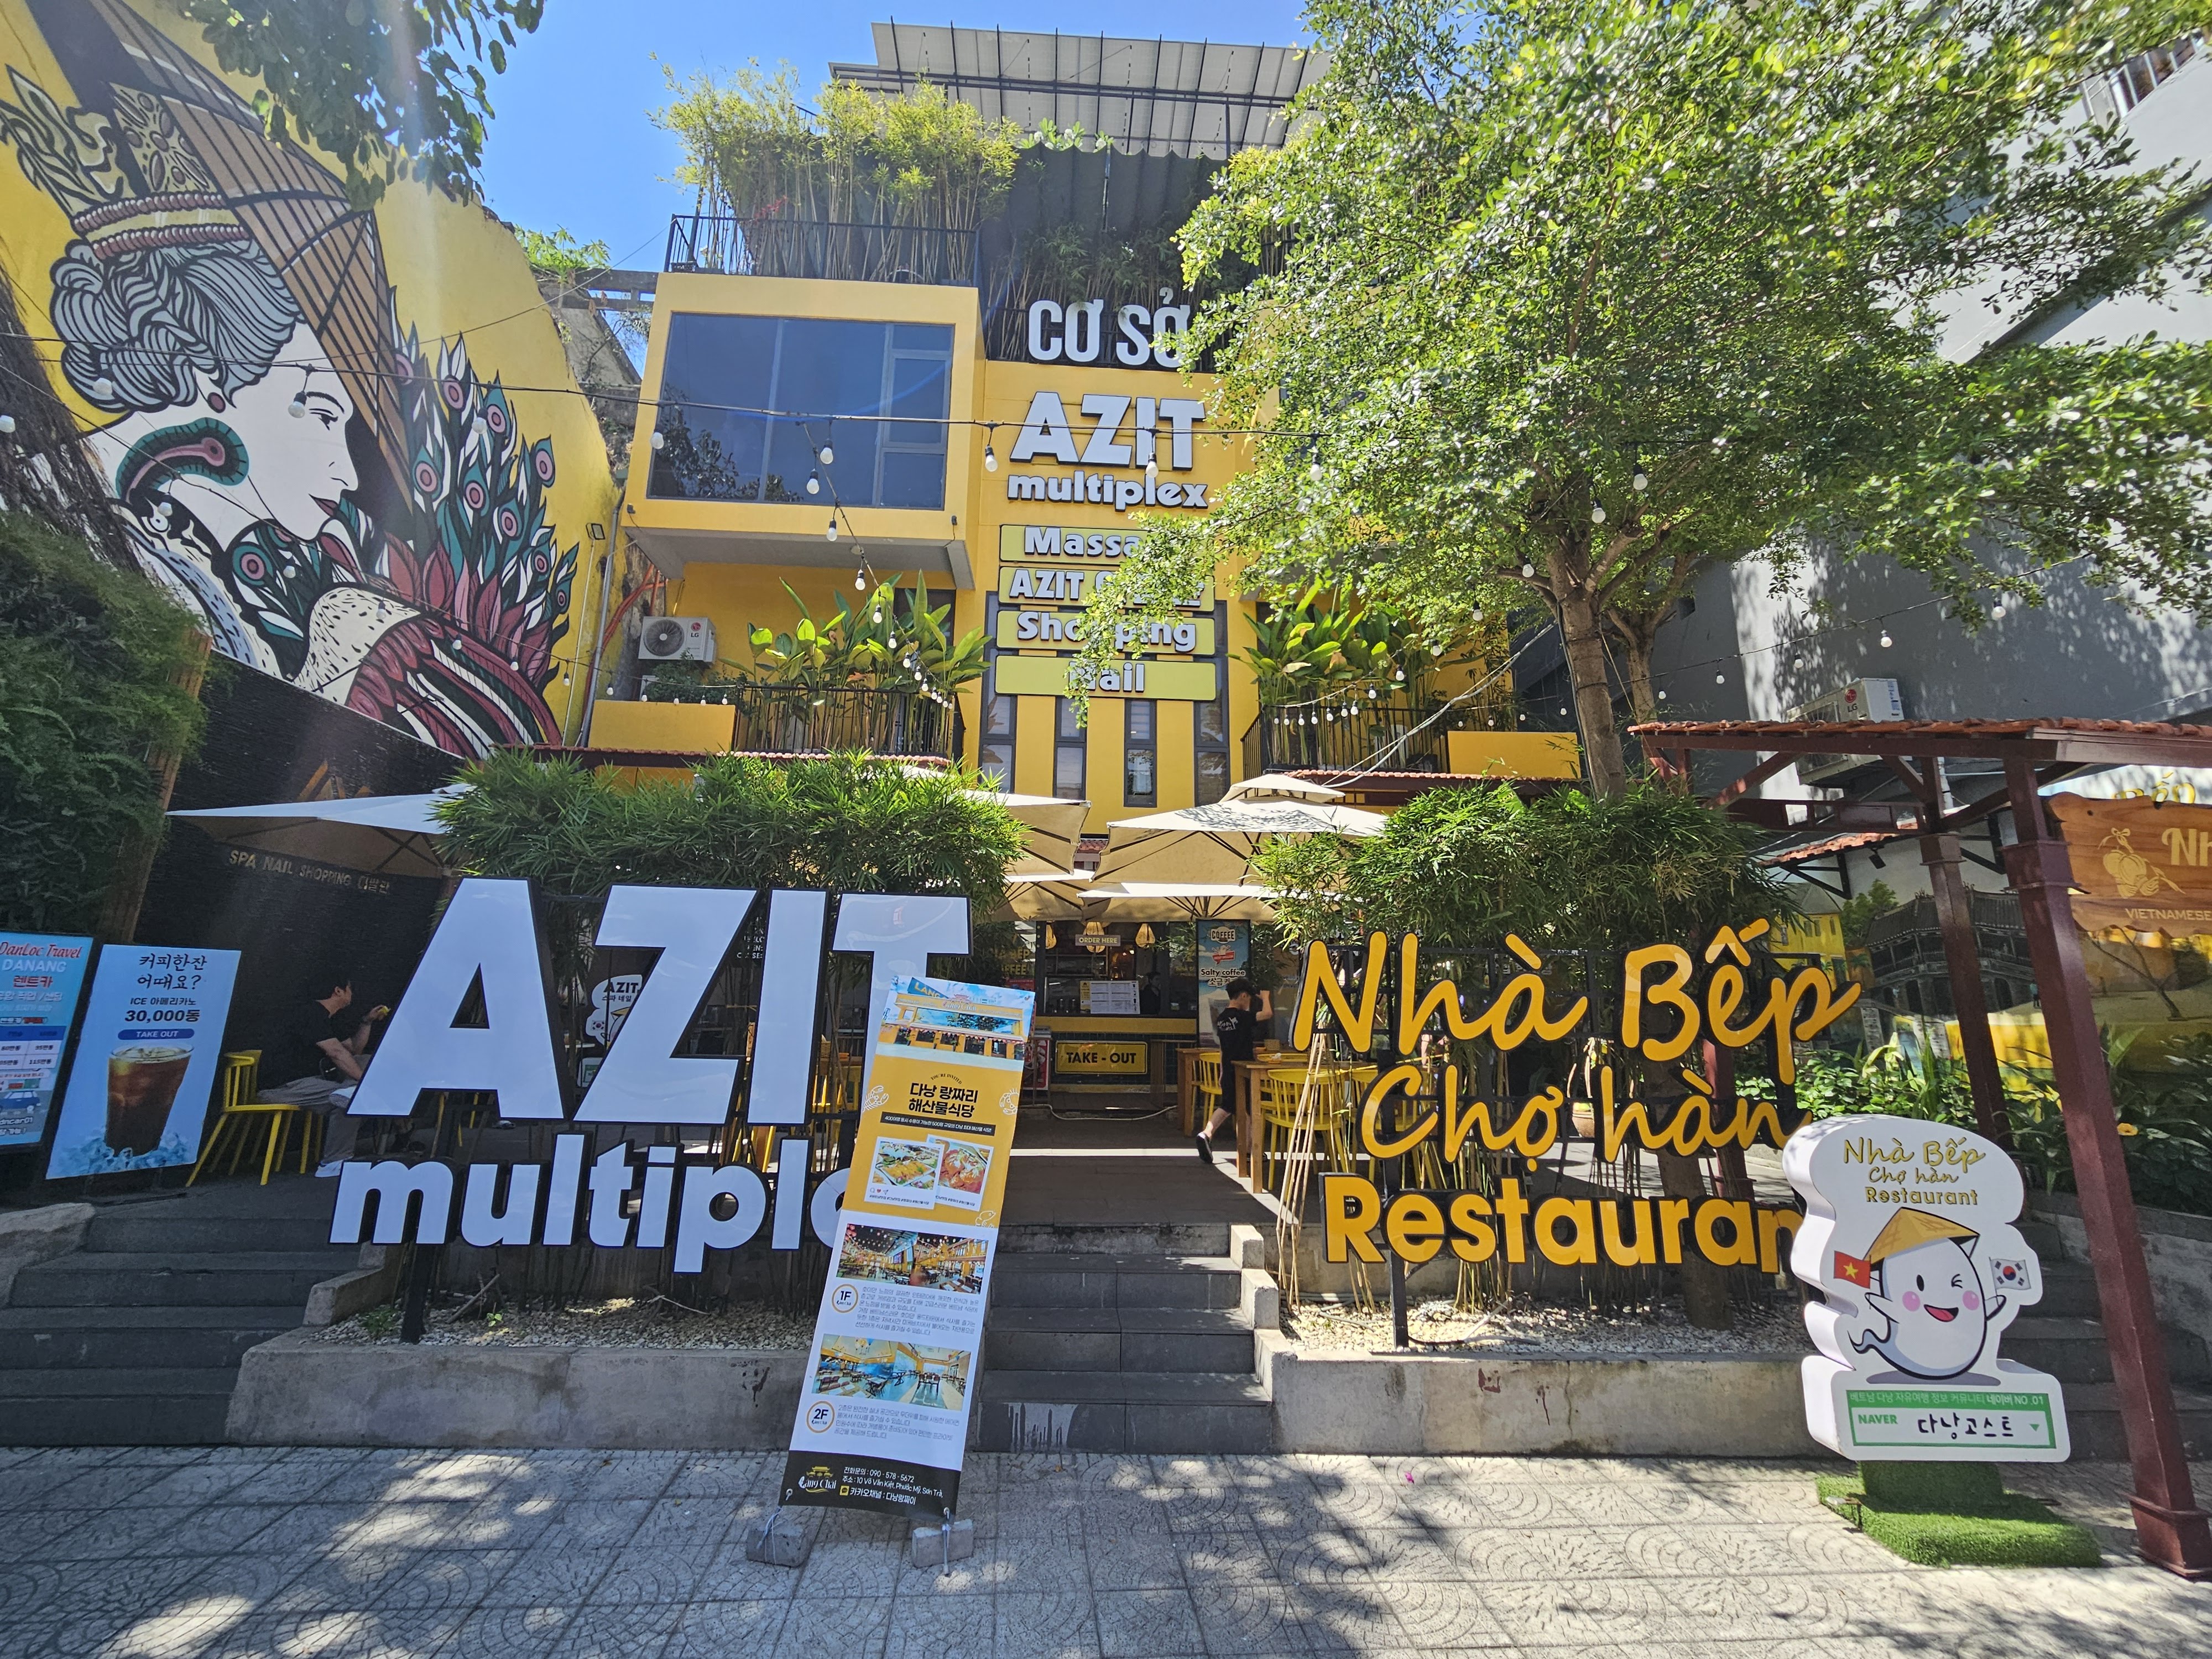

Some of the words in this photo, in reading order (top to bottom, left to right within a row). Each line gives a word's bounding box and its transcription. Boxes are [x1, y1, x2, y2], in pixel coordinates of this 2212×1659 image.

[1029, 299, 1104, 363] CƠ
[1115, 286, 1191, 369] SỞ
[1009, 390, 1206, 471] AZIT
[1008, 470, 1208, 512] multiplex
[1024, 526, 1145, 559] Massa
[1009, 570, 1084, 601] AZIT
[1017, 611, 1196, 653] Shoping
[1847, 703, 1858, 713] LG
[229, 850, 257, 870] SPA
[263, 856, 293, 874] NAIL
[299, 864, 352, 886] SHOPPING
[2125, 907, 2212, 921] VIETNAMESE
[1212, 931, 1234, 940] COFFEE
[0, 942, 44, 956] DanLoc
[46, 944, 83, 958] Travel
[2, 959, 67, 973] DANANG
[139, 953, 207, 972] 커피한잔
[13, 975, 54, 989] 렌트카
[137, 973, 202, 990] 어때요?
[1201, 968, 1220, 978] Salty
[603, 982, 639, 994] AZIT
[150, 997, 197, 1006] 아메리카노
[347, 878, 972, 1125] AZIT
[1292, 930, 1588, 1056] Nhà
[1622, 918, 1862, 1086] Bếp
[124, 1009, 201, 1024] 30,000동
[1066, 1052, 1098, 1065] TAKE
[1109, 1052, 1137, 1065] OUT
[910, 1082, 937, 1098] 다낭
[940, 1086, 979, 1103] 랑짜리
[908, 1098, 975, 1118] 해산물식당
[1360, 1065, 1565, 1173] Chợ
[1600, 1065, 1812, 1164] hàn
[1843, 1136, 1914, 1165] Nhà
[1923, 1136, 1986, 1173] Bếp
[1869, 1166, 1907, 1186] Chợ
[1914, 1168, 1959, 1184] hàn
[330, 1131, 852, 1274] multipl
[1865, 1186, 1978, 1206] Restaurant
[1319, 1173, 1806, 1274] Restauran
[841, 1291, 852, 1301] 1F
[1877, 1393, 1893, 1402] 다낭
[1895, 1393, 1930, 1404] 자유여행
[1931, 1394, 1948, 1404] 정보
[1950, 1394, 1984, 1404] 커뮤니티
[1986, 1395, 2014, 1406] 네이버
[813, 1408, 829, 1420] 2F
[1858, 1413, 1898, 1425] NAVER
[1917, 1412, 2014, 1439] 다낭고스트
[869, 1469, 881, 1478] 090
[885, 1472, 896, 1480] 578
[900, 1474, 915, 1483] 5672
[850, 1486, 882, 1499] 카카오채널
[886, 1492, 916, 1505] 다낭랑짜이
